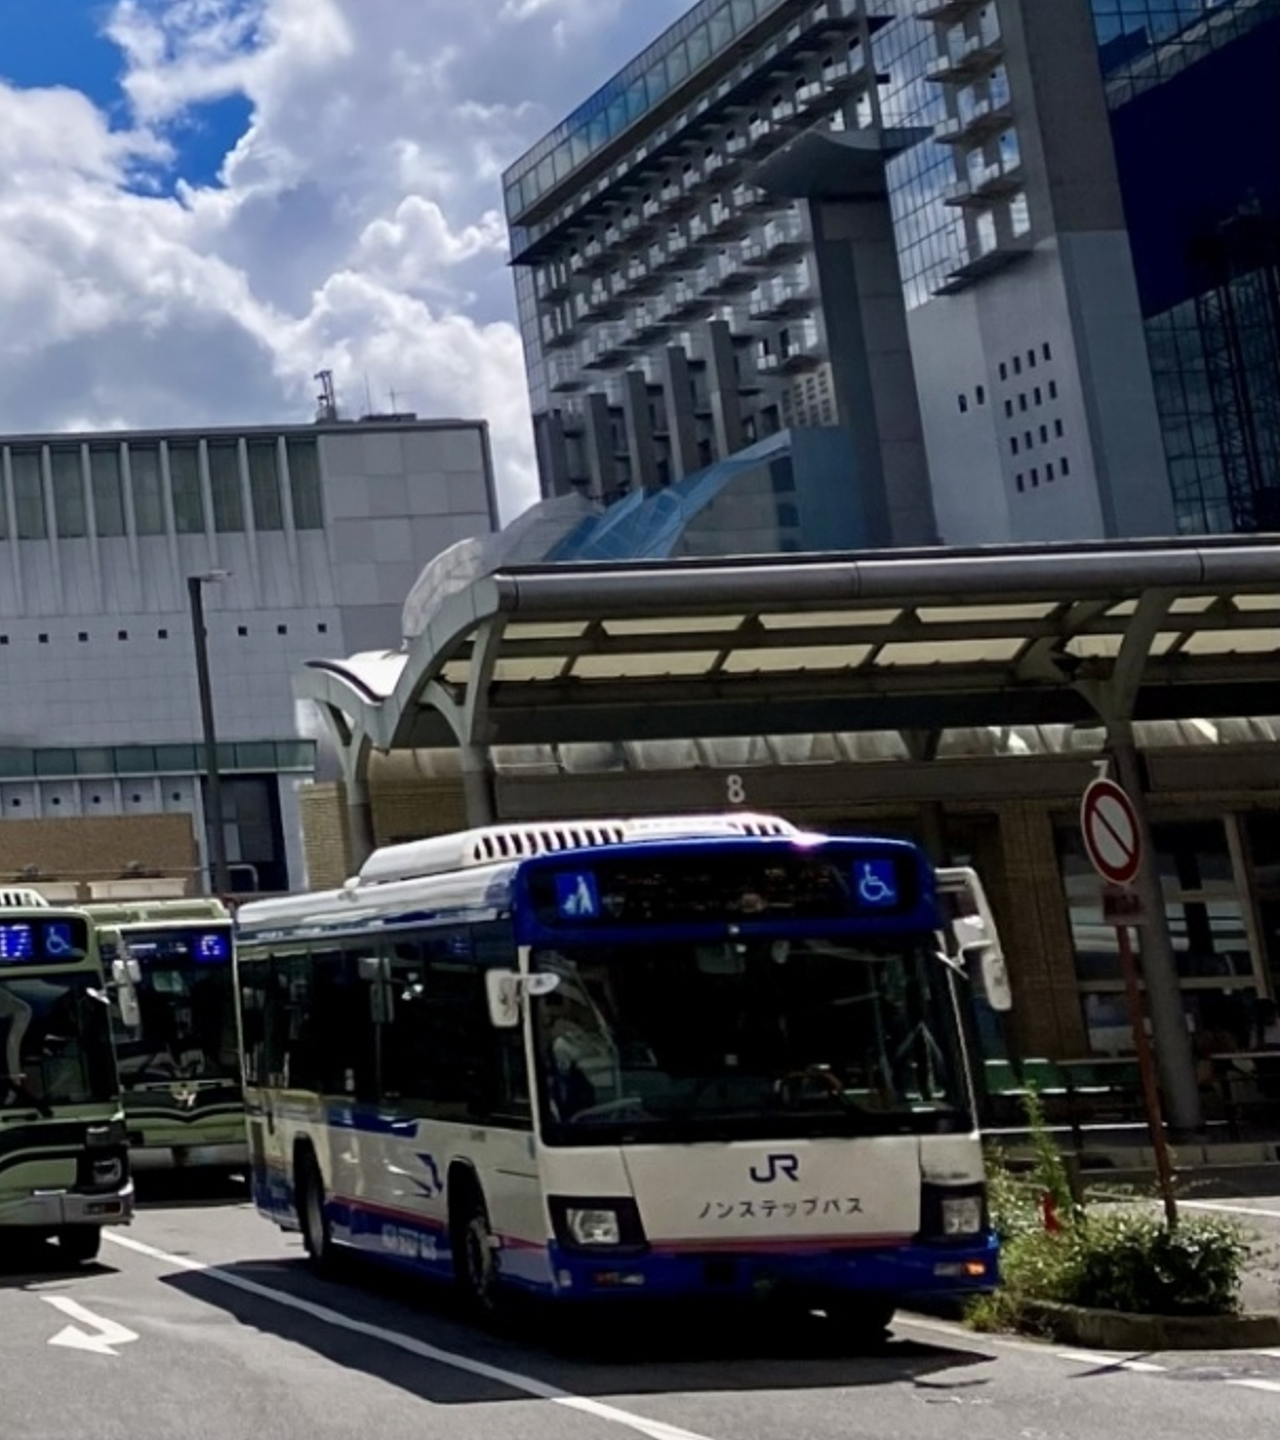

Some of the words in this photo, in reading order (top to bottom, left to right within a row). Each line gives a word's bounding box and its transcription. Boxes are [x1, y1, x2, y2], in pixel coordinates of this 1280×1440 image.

[727, 774, 745, 803] 8
[750, 1154, 799, 1183] JR
[699, 1197, 863, 1219] ノンステップバス
